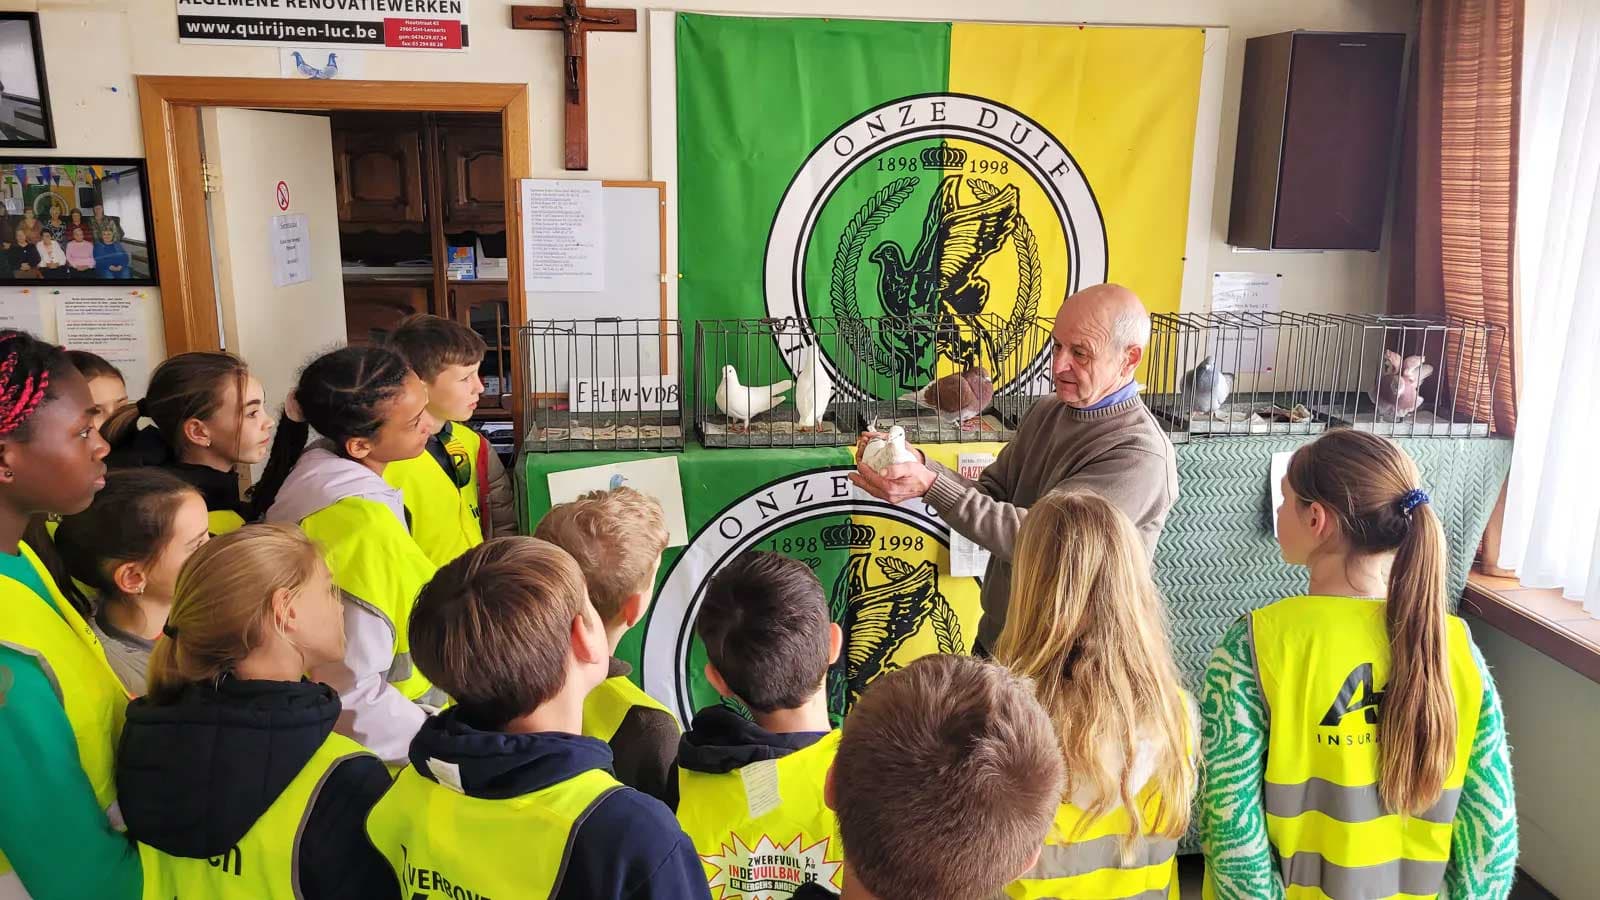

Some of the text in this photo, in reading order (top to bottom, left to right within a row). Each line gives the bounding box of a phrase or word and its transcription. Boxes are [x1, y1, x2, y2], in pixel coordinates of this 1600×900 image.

[286, 0, 462, 13] RENOVATIEWERKEN
[186, 20, 377, 39] www.quirijnen-luc.be
[834, 102, 1071, 179] ONZE DUIF
[877, 157, 918, 172] 1898
[970, 160, 1009, 175] 1998
[719, 475, 850, 539] ONZE
[770, 537, 817, 553] 1898
[879, 536, 924, 551] 1998
[1317, 733, 1379, 746] INSUR
[748, 855, 801, 869] ZWERFVUIL
[408, 863, 492, 900] VERBOV
[774, 881, 799, 893] ANDER
